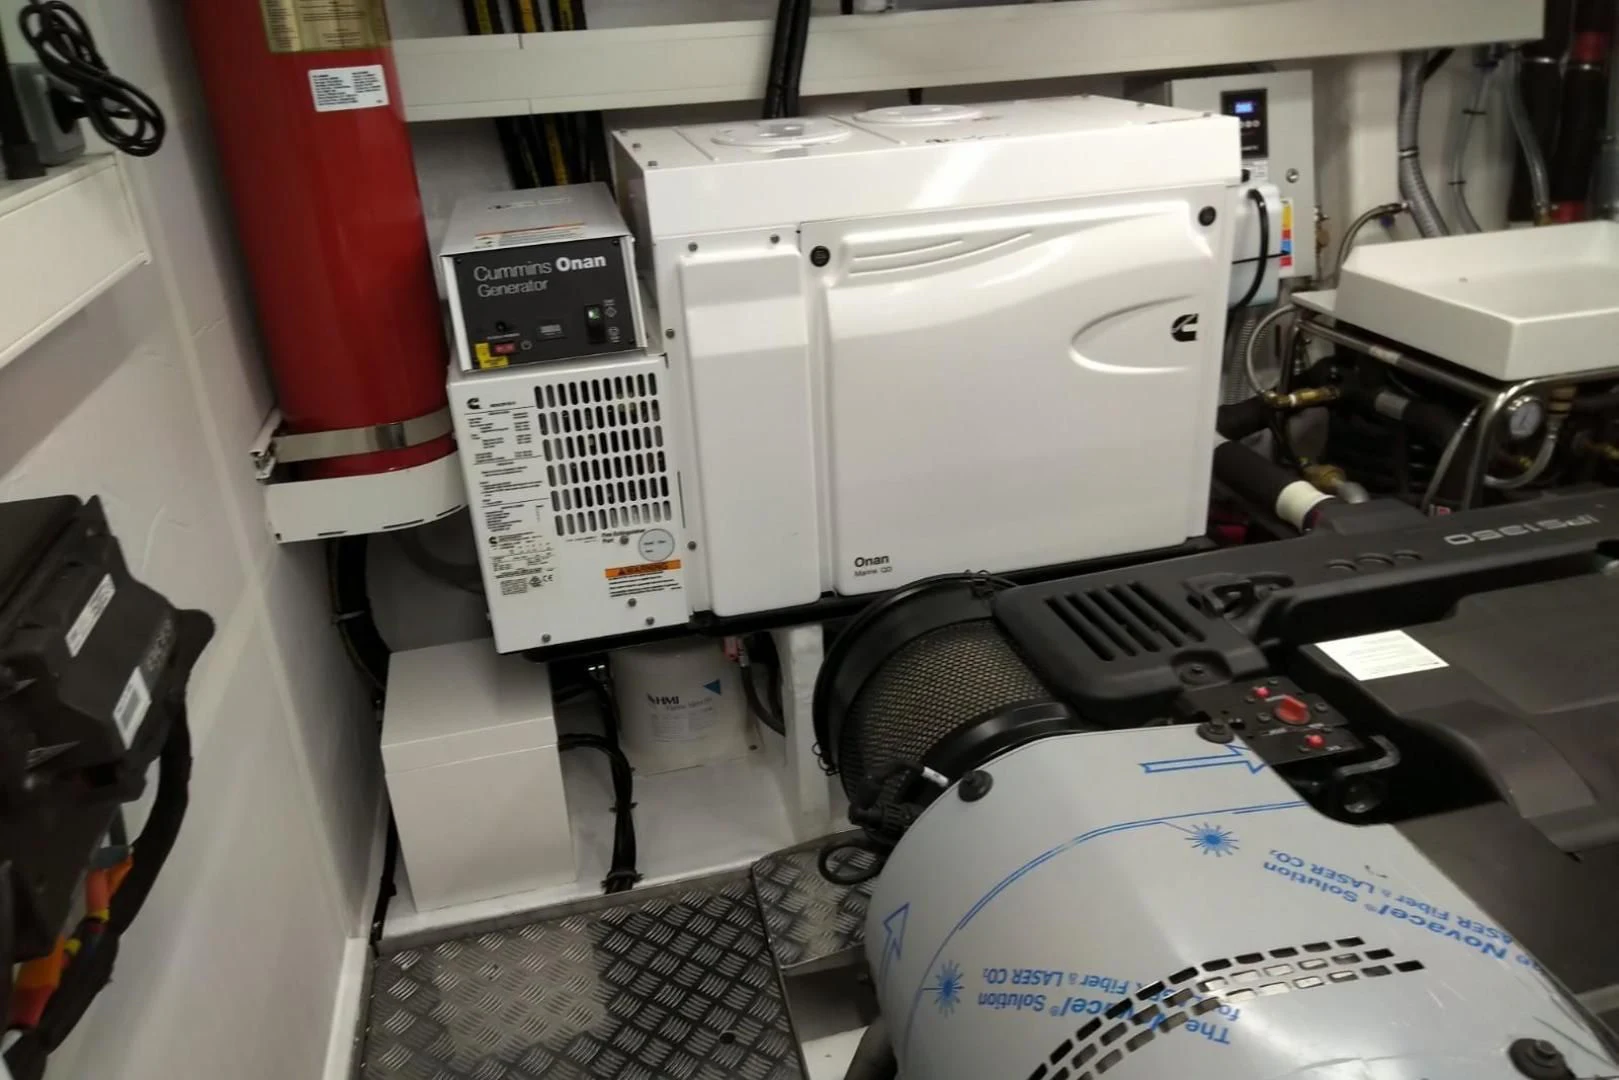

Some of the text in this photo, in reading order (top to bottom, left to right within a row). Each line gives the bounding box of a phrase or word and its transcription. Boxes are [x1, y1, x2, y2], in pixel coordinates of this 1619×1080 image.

[473, 256, 607, 282] Cummins Onan
[477, 279, 549, 298] Generator
[854, 554, 890, 568] Onan
[1263, 861, 1360, 904] Solution
[1311, 863, 1375, 896] LASER
[1398, 893, 1450, 922] Fiber
[1012, 969, 1064, 987] LASER
[1081, 975, 1129, 995] Fiber
[978, 992, 1046, 1011] Solution
[1185, 1019, 1231, 1046] The
